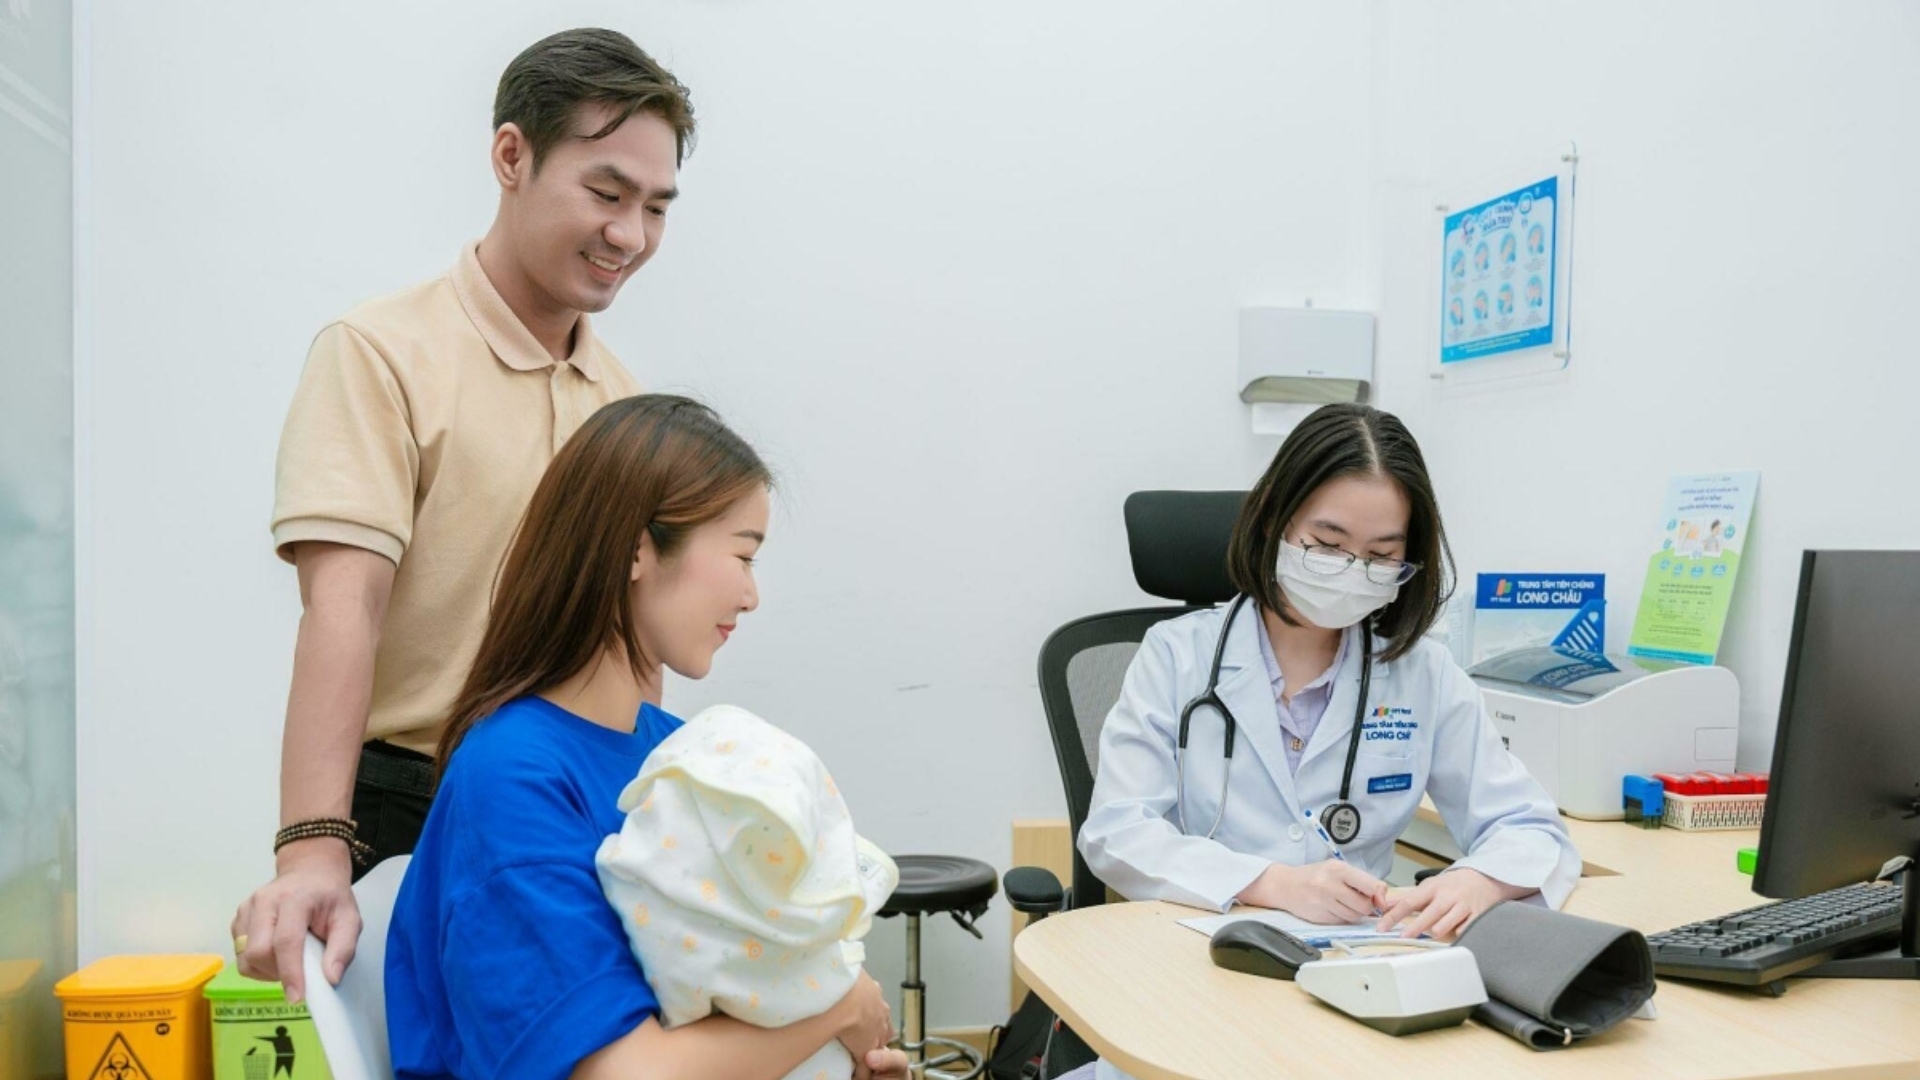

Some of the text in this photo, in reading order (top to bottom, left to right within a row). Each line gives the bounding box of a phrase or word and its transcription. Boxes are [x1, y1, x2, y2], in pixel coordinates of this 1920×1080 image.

[1517, 580, 1540, 589] TRUNG
[1516, 589, 1582, 604] LONG CHÂU
[1366, 731, 1395, 741] LONG
